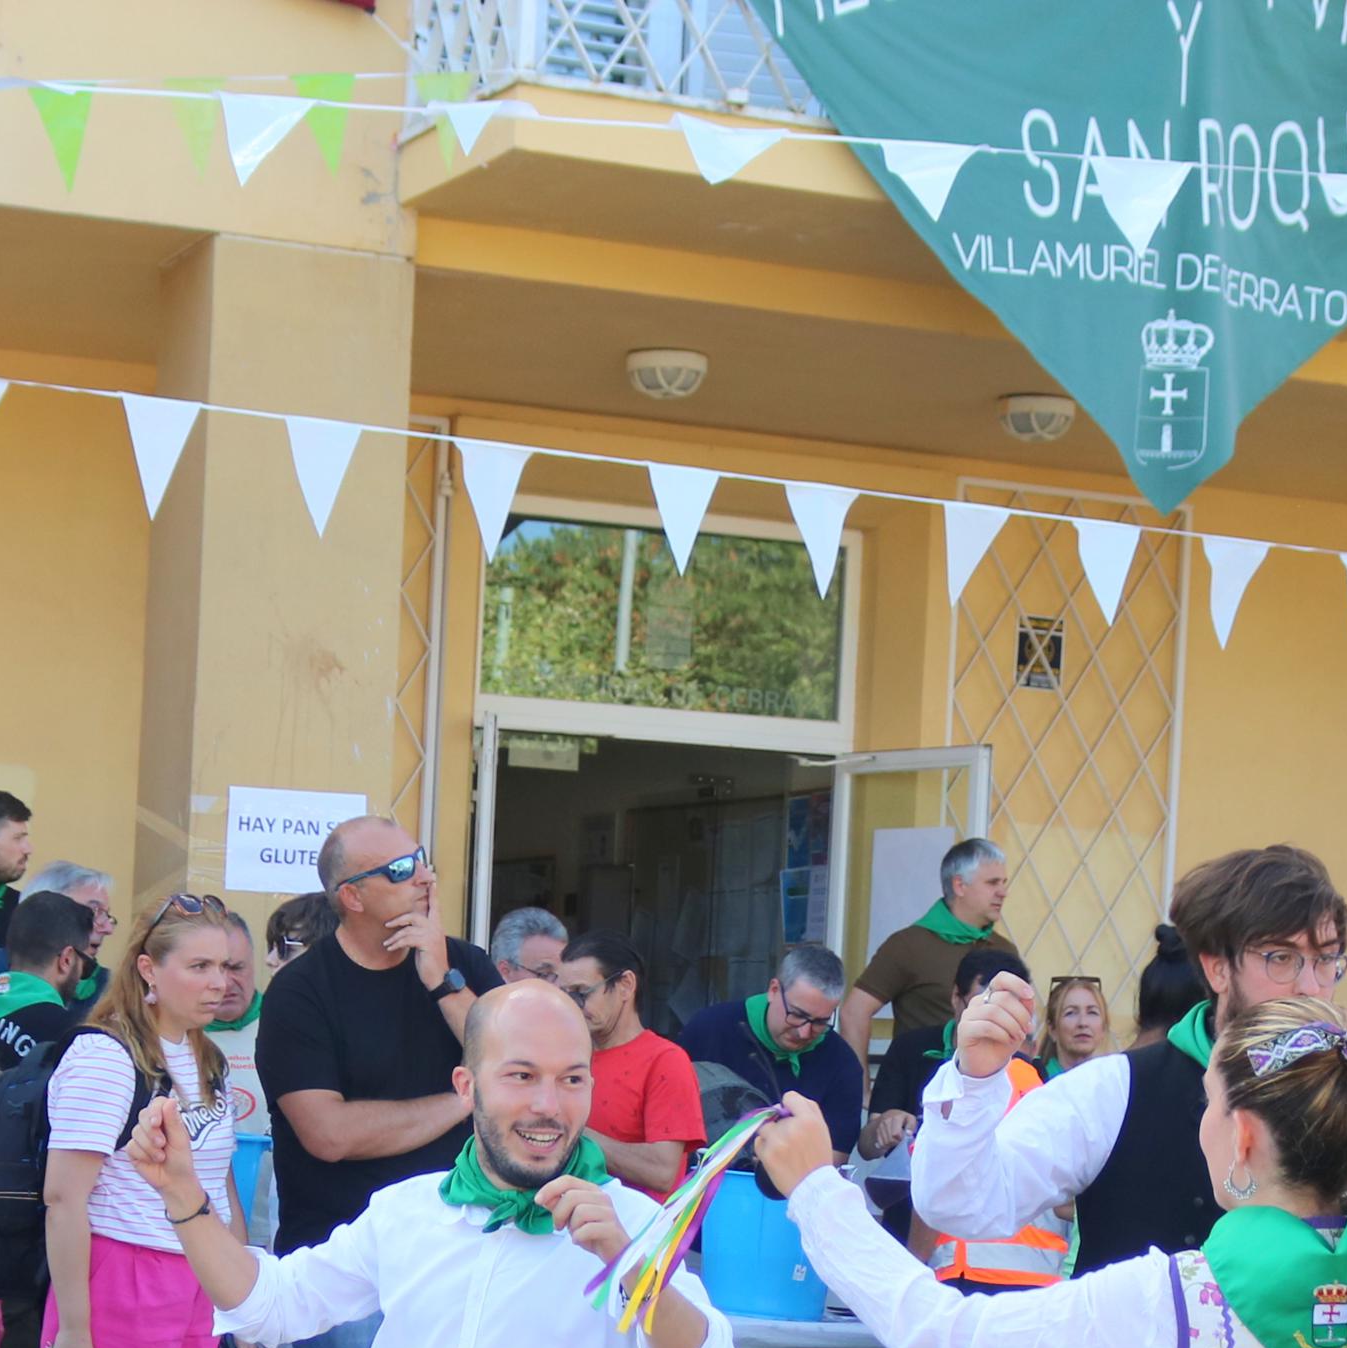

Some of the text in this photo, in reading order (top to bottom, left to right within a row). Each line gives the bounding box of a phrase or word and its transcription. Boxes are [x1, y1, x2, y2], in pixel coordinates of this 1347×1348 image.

[1165, 0, 1203, 106] Y
[952, 231, 1166, 289] VILLAMURIEL
[238, 815, 277, 833] HAY
[282, 819, 320, 836] PAN
[259, 847, 319, 866] GLUTE
